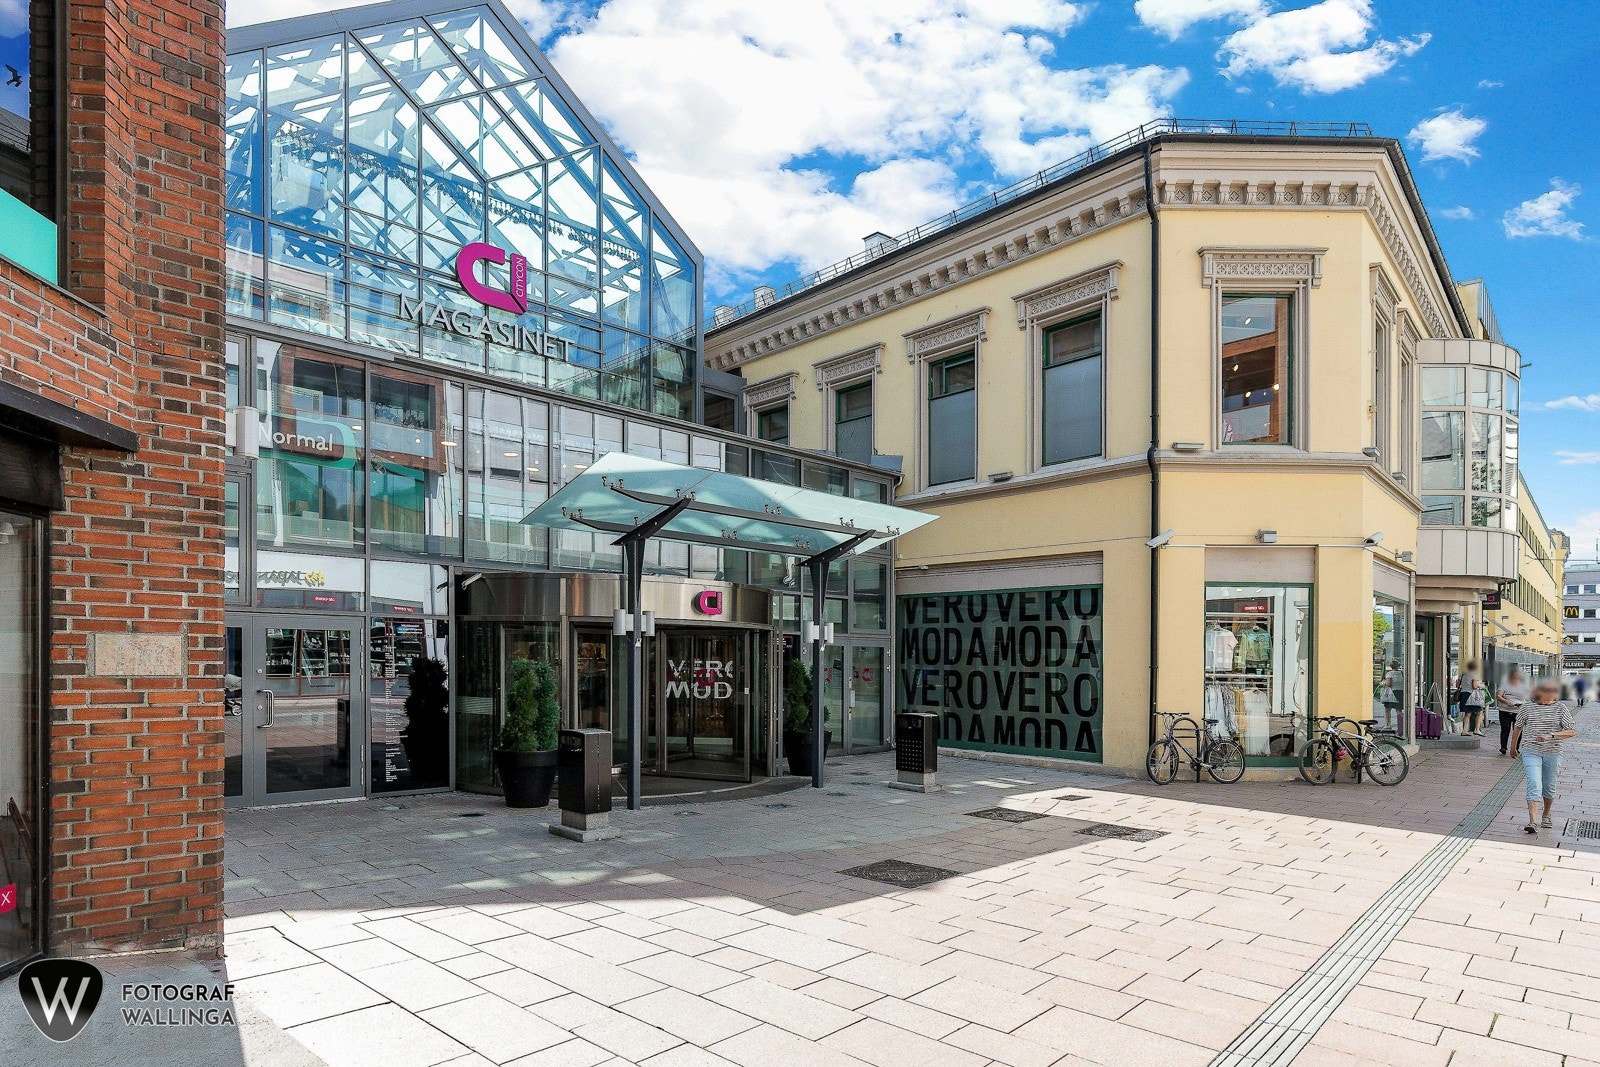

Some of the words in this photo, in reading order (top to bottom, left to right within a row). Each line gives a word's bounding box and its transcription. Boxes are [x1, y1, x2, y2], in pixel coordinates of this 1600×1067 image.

[516, 257, 524, 298] CITYCON
[399, 292, 576, 362] MAGASINET
[258, 420, 333, 452] Normal
[996, 588, 1099, 622] VERO
[901, 626, 988, 667] MODA
[993, 625, 1099, 668] MODA
[901, 668, 988, 710] VERO
[993, 671, 1099, 718] VERO
[993, 715, 1097, 753] MODA
